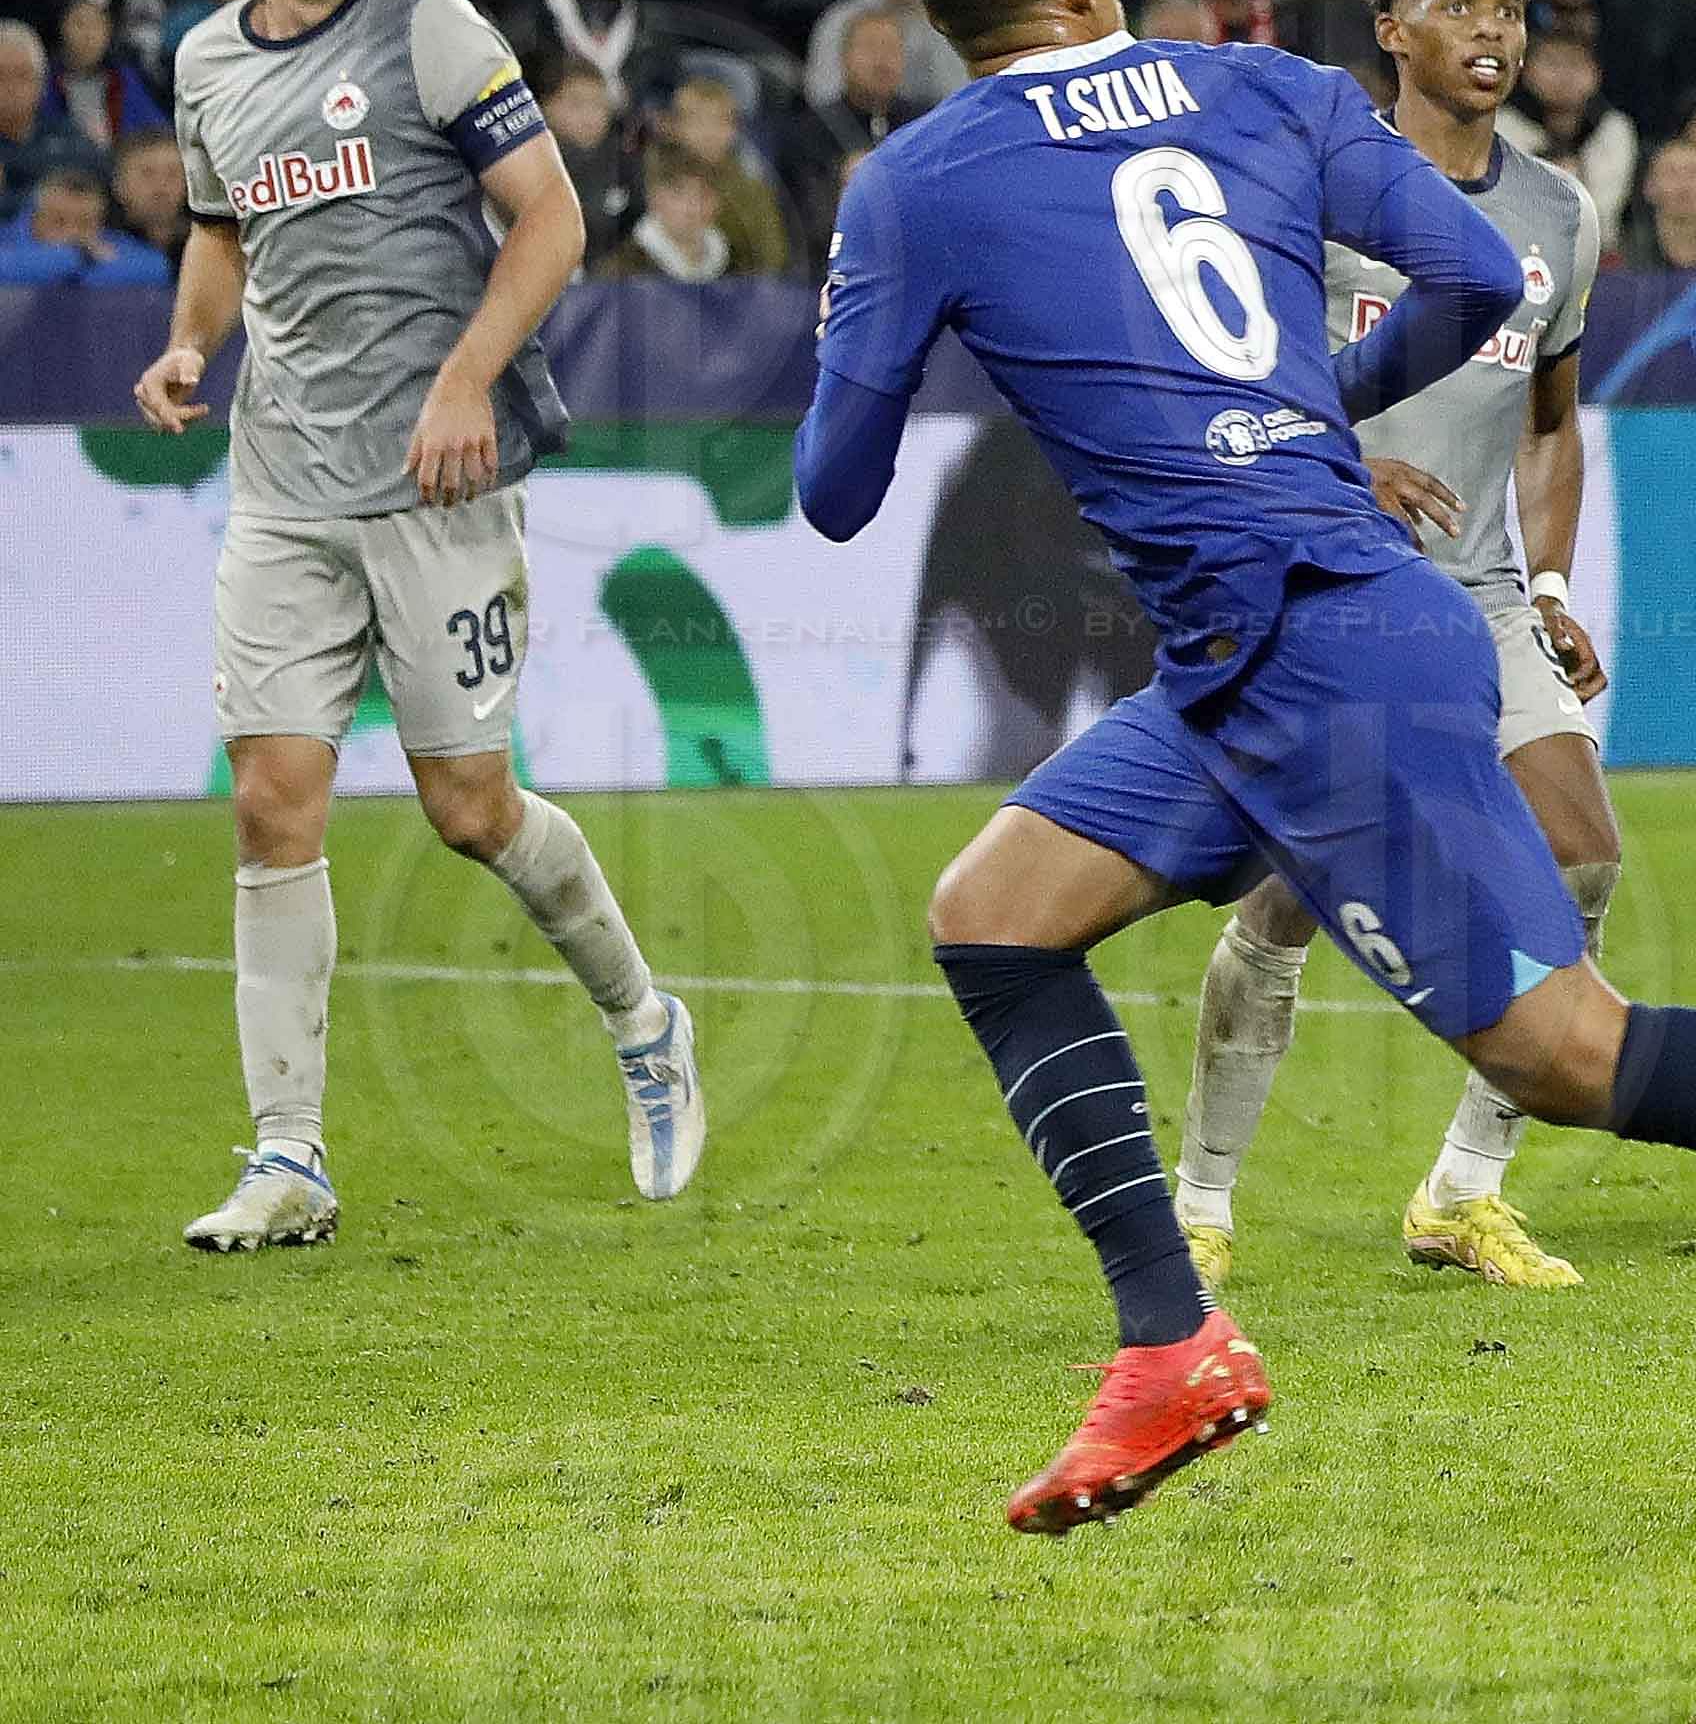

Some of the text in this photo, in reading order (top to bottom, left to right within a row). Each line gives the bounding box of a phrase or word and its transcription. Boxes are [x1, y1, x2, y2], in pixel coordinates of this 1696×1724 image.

[1024, 60, 1200, 140] T.SILVA
[230, 142, 372, 213] ed Bull
[1110, 146, 1281, 382] 6
[447, 594, 512, 692] 39
[1338, 900, 1412, 987] 6
